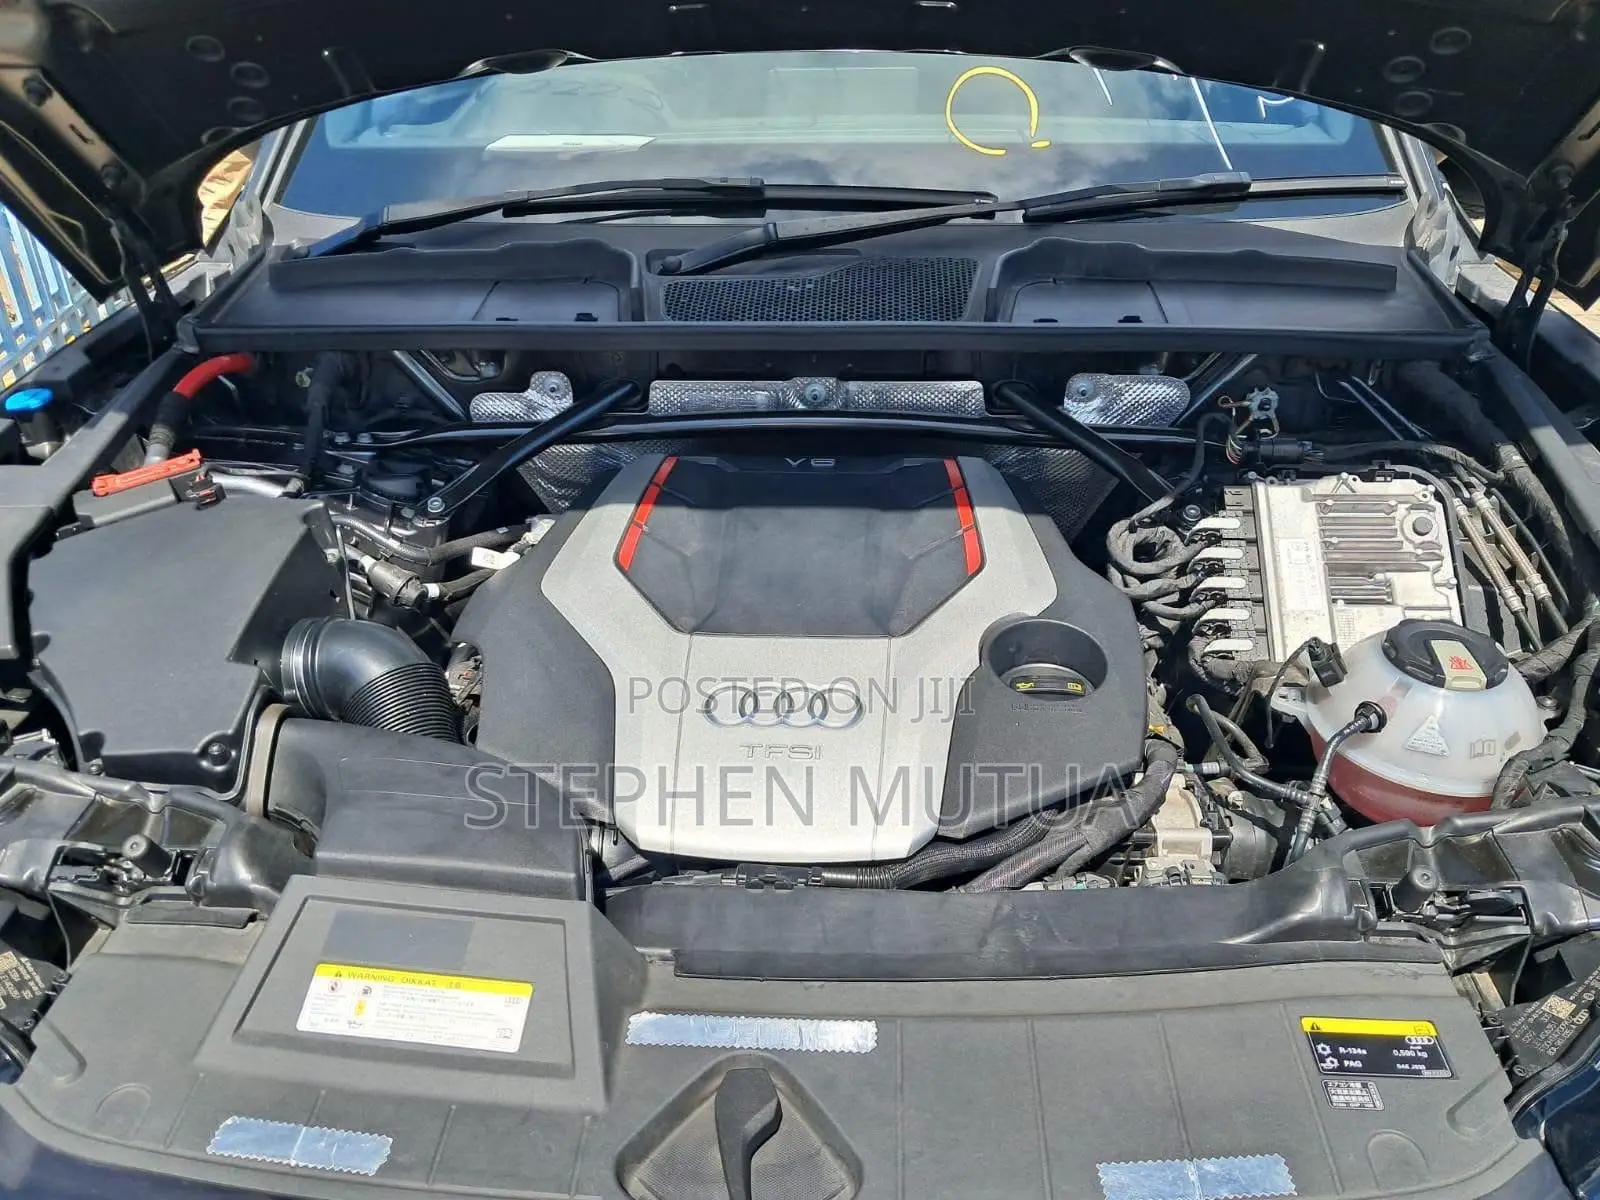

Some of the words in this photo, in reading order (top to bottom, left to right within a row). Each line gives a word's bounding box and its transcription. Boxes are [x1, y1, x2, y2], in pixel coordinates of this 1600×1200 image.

[784, 457, 836, 468] V6
[737, 744, 822, 761] TFSI
[348, 971, 395, 983] WARNING
[401, 976, 437, 987] DIKKAT
